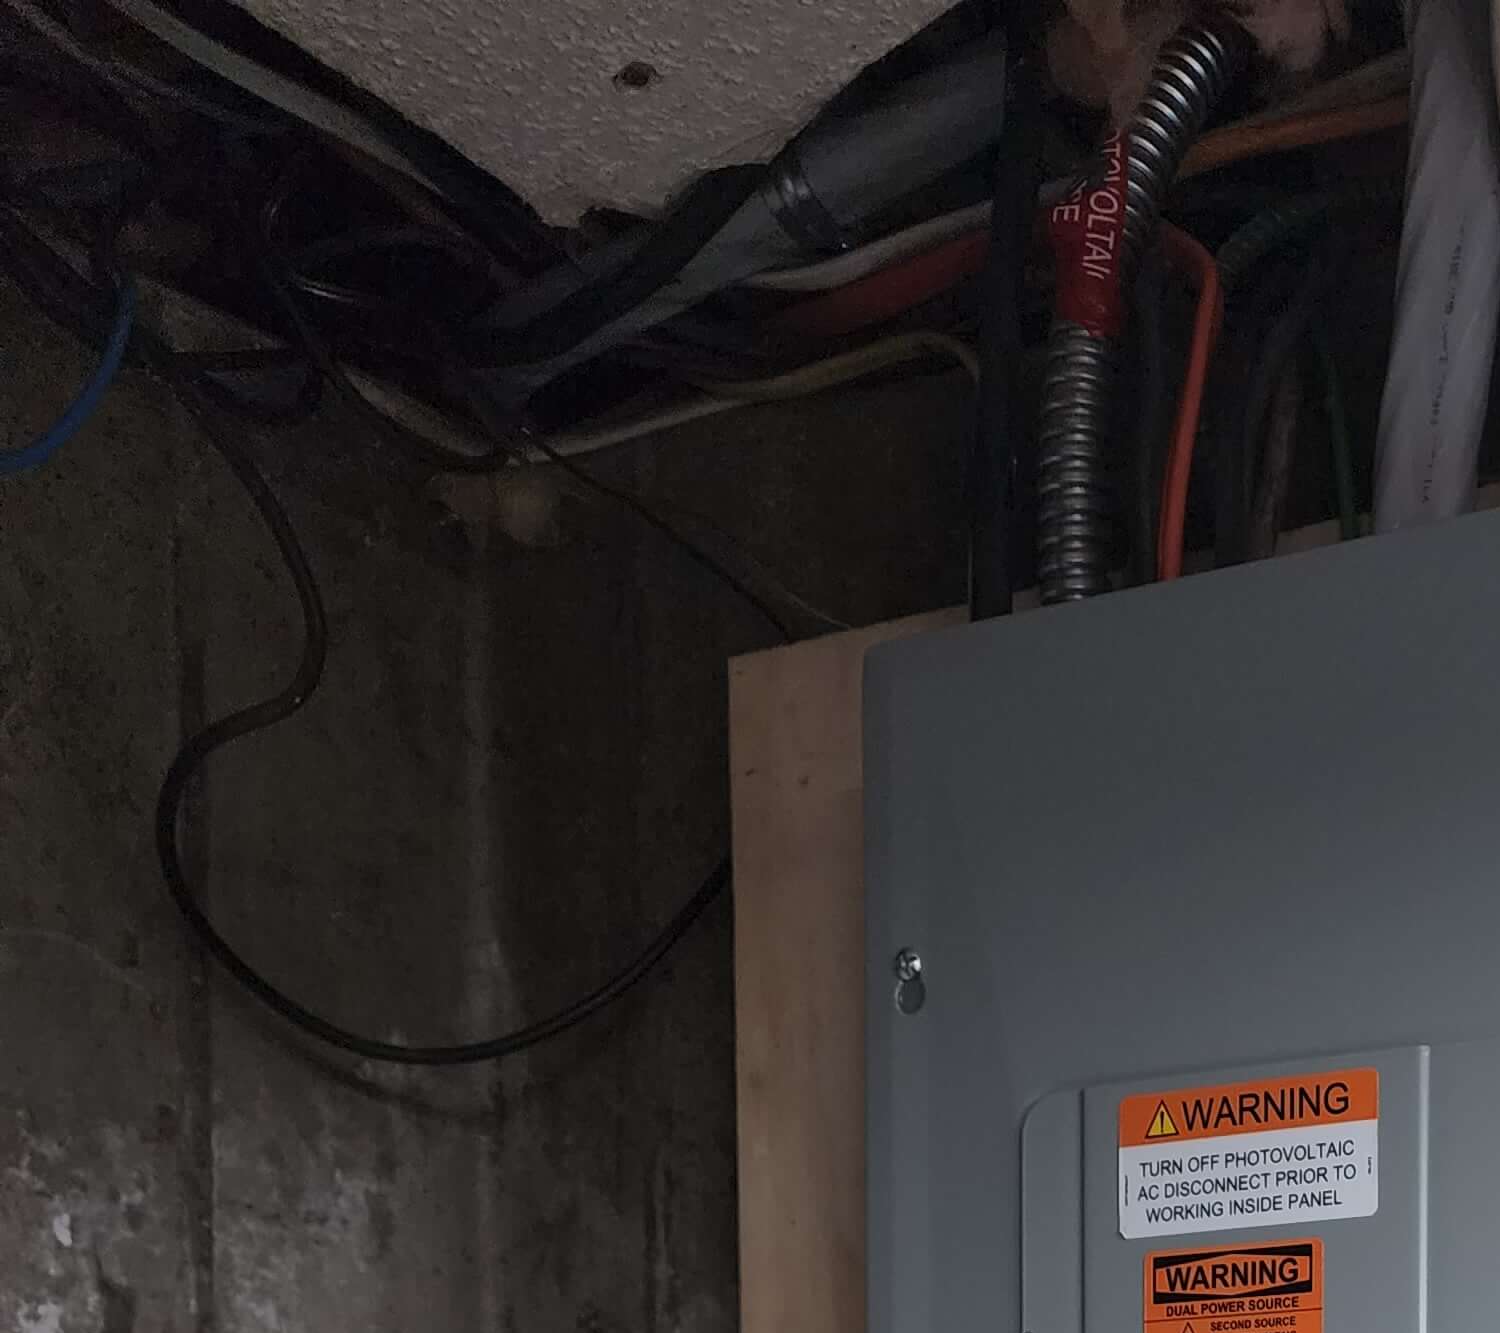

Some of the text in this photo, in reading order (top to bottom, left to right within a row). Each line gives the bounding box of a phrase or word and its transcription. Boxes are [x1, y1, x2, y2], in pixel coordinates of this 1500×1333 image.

[1182, 1082, 1350, 1131] WARNING
[1139, 1158, 1183, 1177] TURN
[1188, 1154, 1220, 1174] OFF
[1224, 1140, 1354, 1169] PHOTOVOLTAIC
[1138, 1184, 1160, 1201] AC
[1164, 1173, 1269, 1199] DISCONNECT
[1276, 1167, 1328, 1188] PRIOR
[1333, 1164, 1356, 1181] TO
[1146, 1190, 1342, 1223] WORKING INSIDE PANEL
[1166, 1257, 1299, 1292] WARNING
[1166, 1296, 1299, 1317] DUAL POWER SOURCE
[1210, 1316, 1296, 1331] SECOND SOURCE
